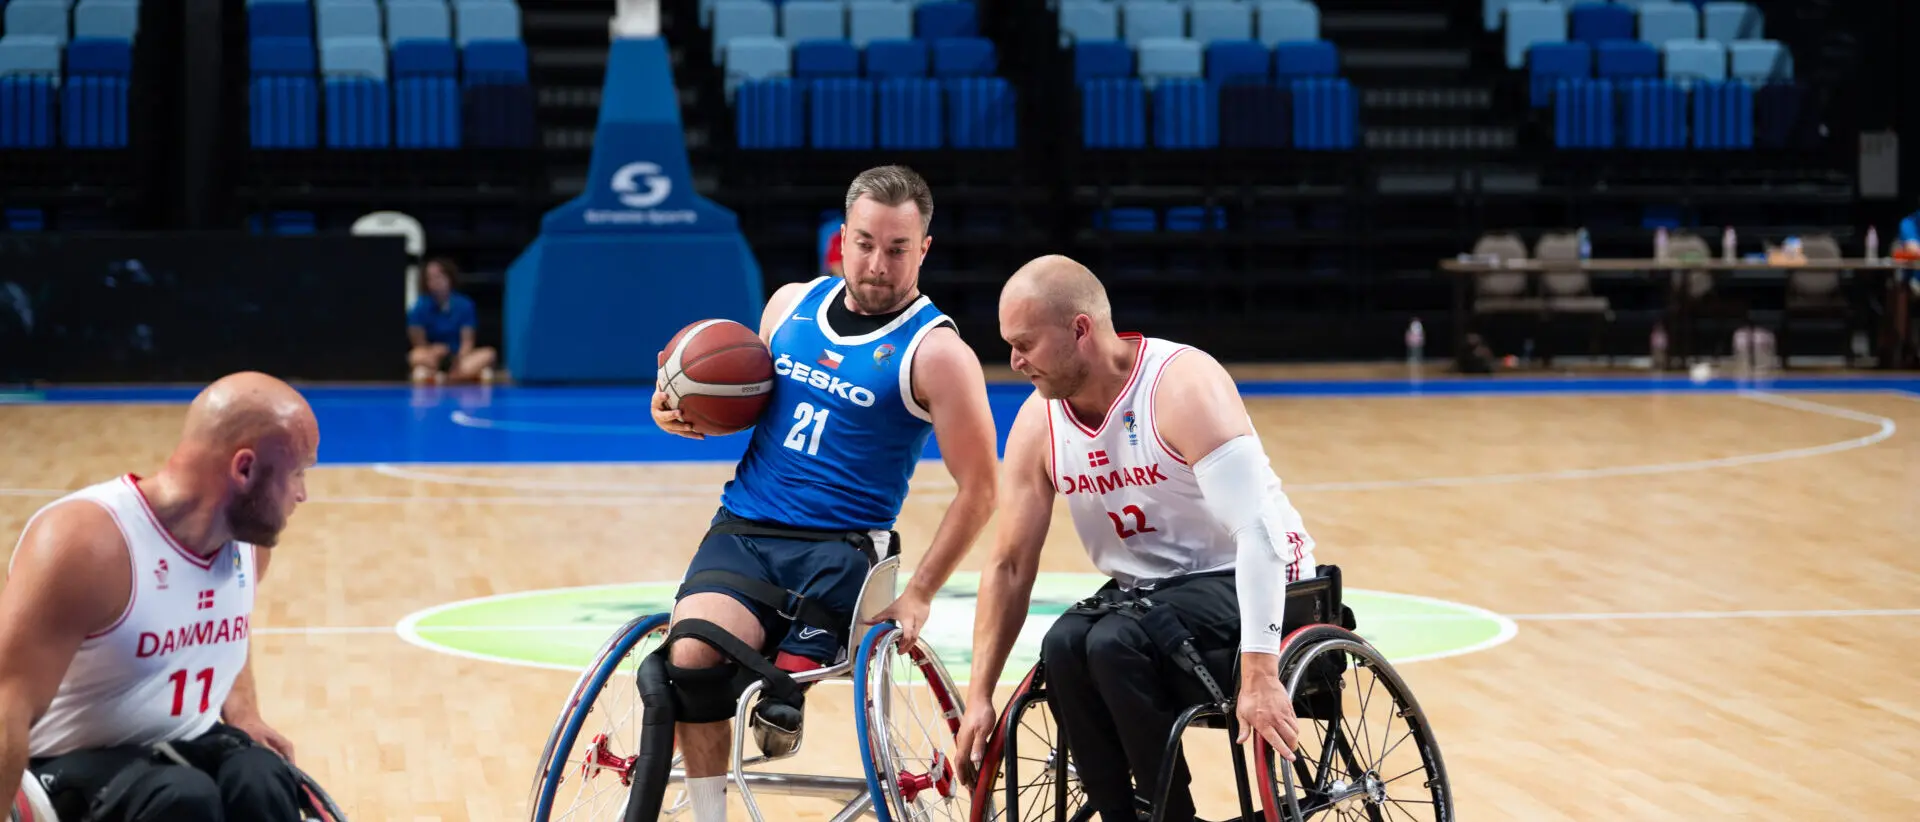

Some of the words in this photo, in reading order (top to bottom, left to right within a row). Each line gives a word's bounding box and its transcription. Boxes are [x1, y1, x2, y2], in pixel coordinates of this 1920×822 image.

[774, 353, 876, 408] ČESKO
[783, 402, 829, 456] 21
[168, 667, 214, 717] 11
